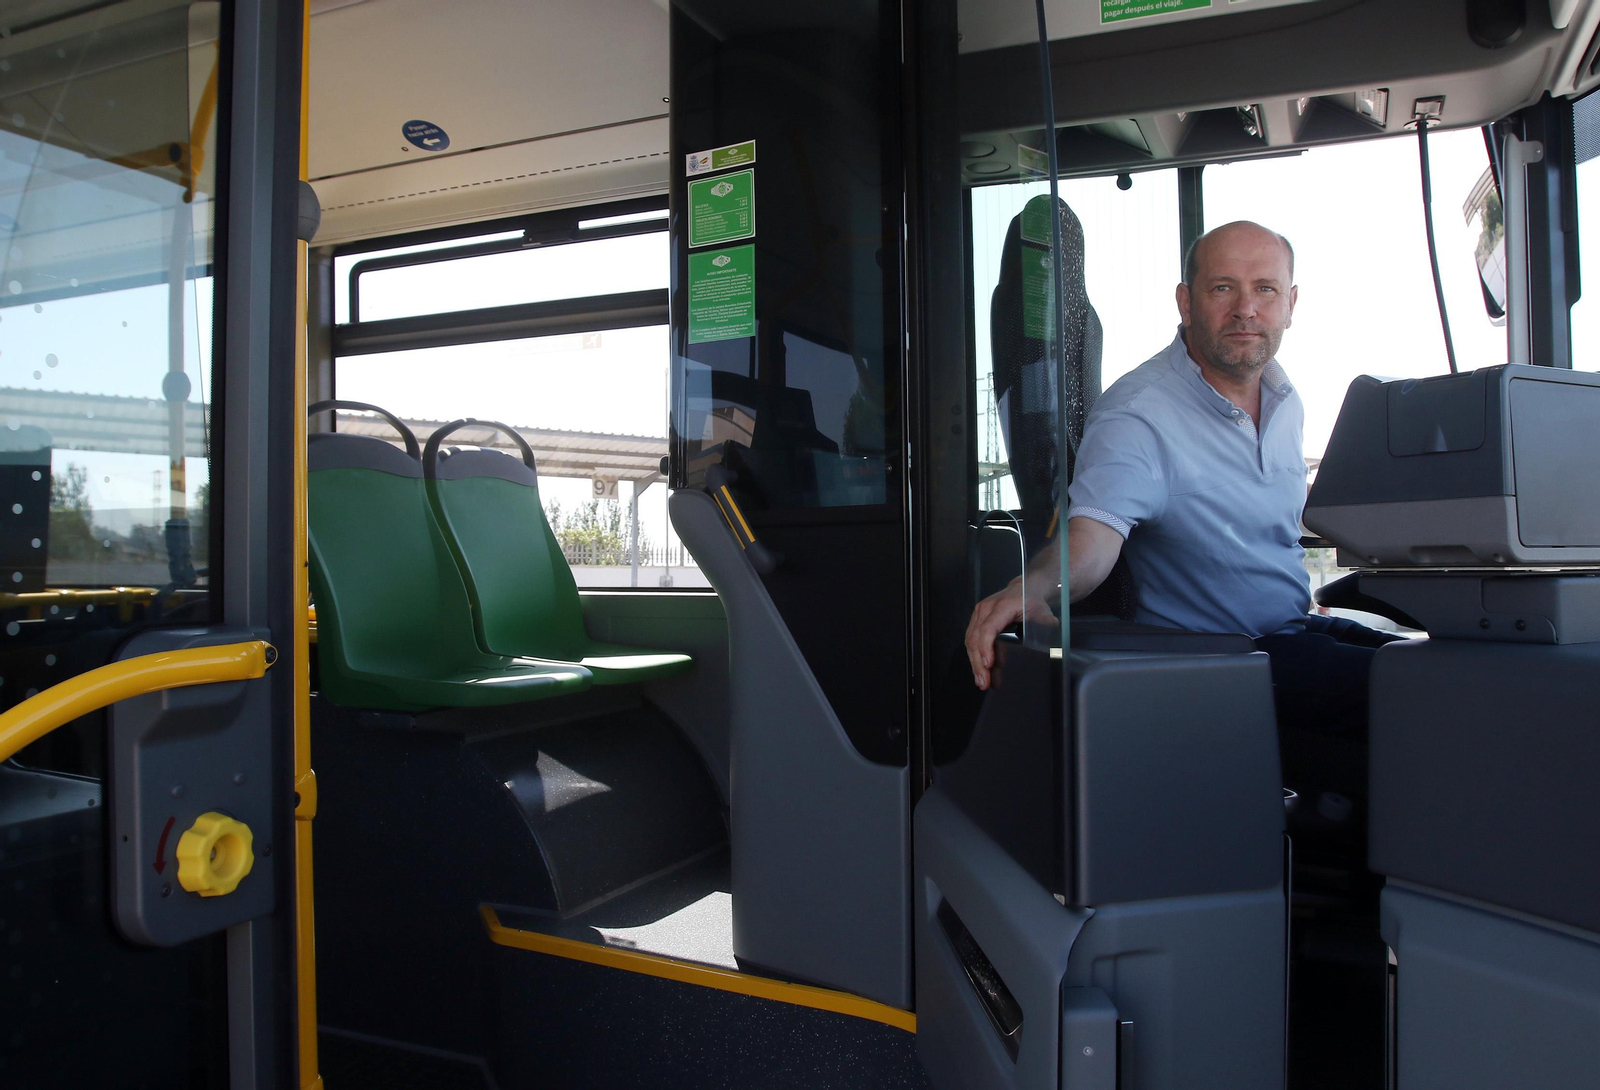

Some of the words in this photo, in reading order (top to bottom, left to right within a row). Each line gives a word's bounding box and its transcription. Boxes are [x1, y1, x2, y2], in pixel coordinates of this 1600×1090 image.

[1104, 9, 1123, 19] pagar
[1124, 5, 1154, 14] después
[1163, 0, 1183, 8] viaje.
[594, 480, 618, 495] 97
